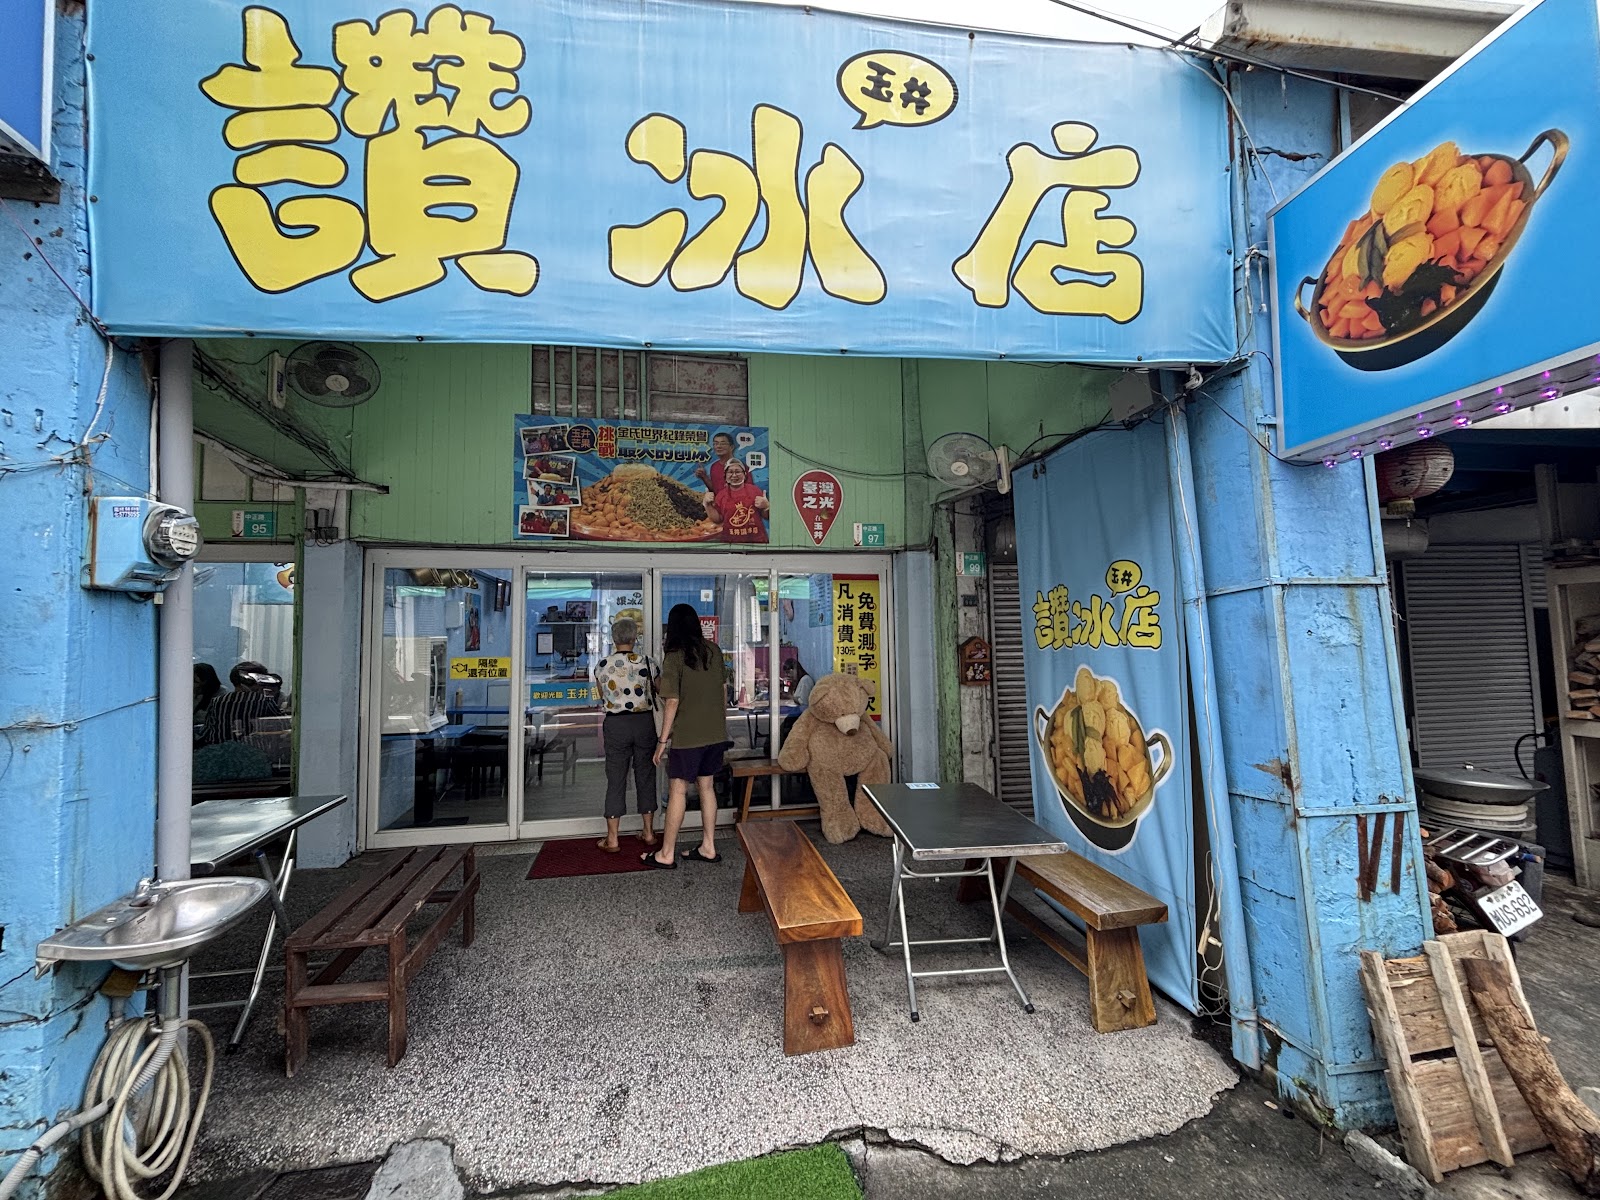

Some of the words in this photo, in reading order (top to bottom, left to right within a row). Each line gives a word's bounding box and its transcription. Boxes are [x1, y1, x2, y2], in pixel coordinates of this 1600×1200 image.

[860, 60, 932, 115] 玉井
[198, 3, 1145, 324] 讚冰店
[571, 428, 591, 438] 玉井
[571, 438, 591, 449] 芒果
[598, 426, 616, 458] 挑戰
[802, 481, 834, 495] 臺灣
[802, 496, 834, 510] 之光
[251, 523, 267, 534] 95
[867, 534, 879, 543] 97
[969, 563, 980, 572] 99
[1111, 567, 1133, 587] 玉井
[1032, 583, 1163, 650] 讚冰店
[836, 646, 856, 656] 130元
[477, 658, 498, 668] 隔壁
[467, 668, 508, 678] 還有位置
